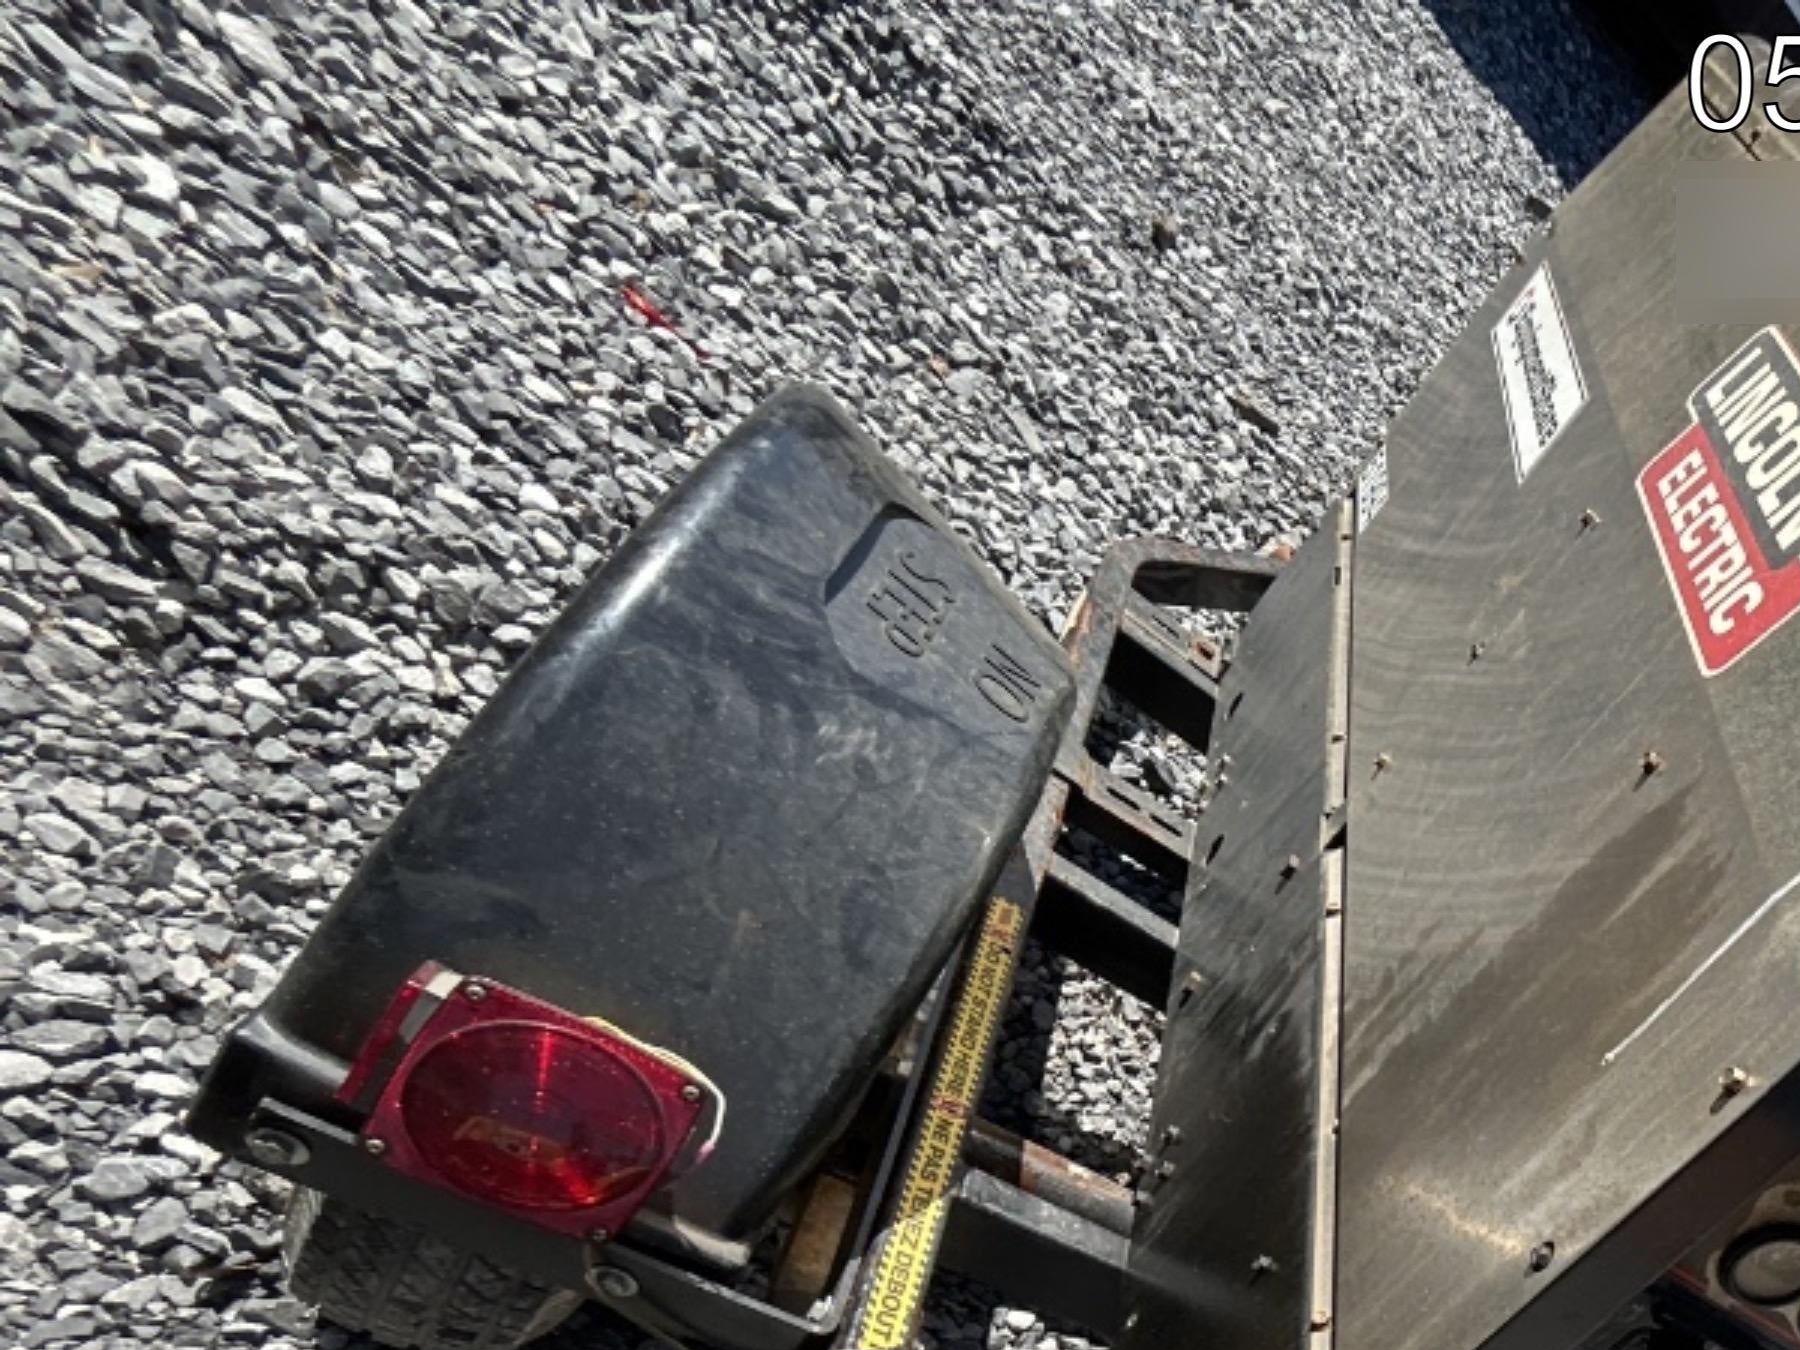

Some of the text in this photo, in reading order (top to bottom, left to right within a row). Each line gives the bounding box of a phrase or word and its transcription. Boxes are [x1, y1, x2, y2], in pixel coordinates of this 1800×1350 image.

[1657, 447, 1766, 638] ELECTRIC
[866, 549, 956, 661] STEP
[976, 642, 1042, 723] NO
[921, 1145, 945, 1179] PAS
[934, 1119, 955, 1142] NE
[873, 1251, 914, 1342] DEBOUT
